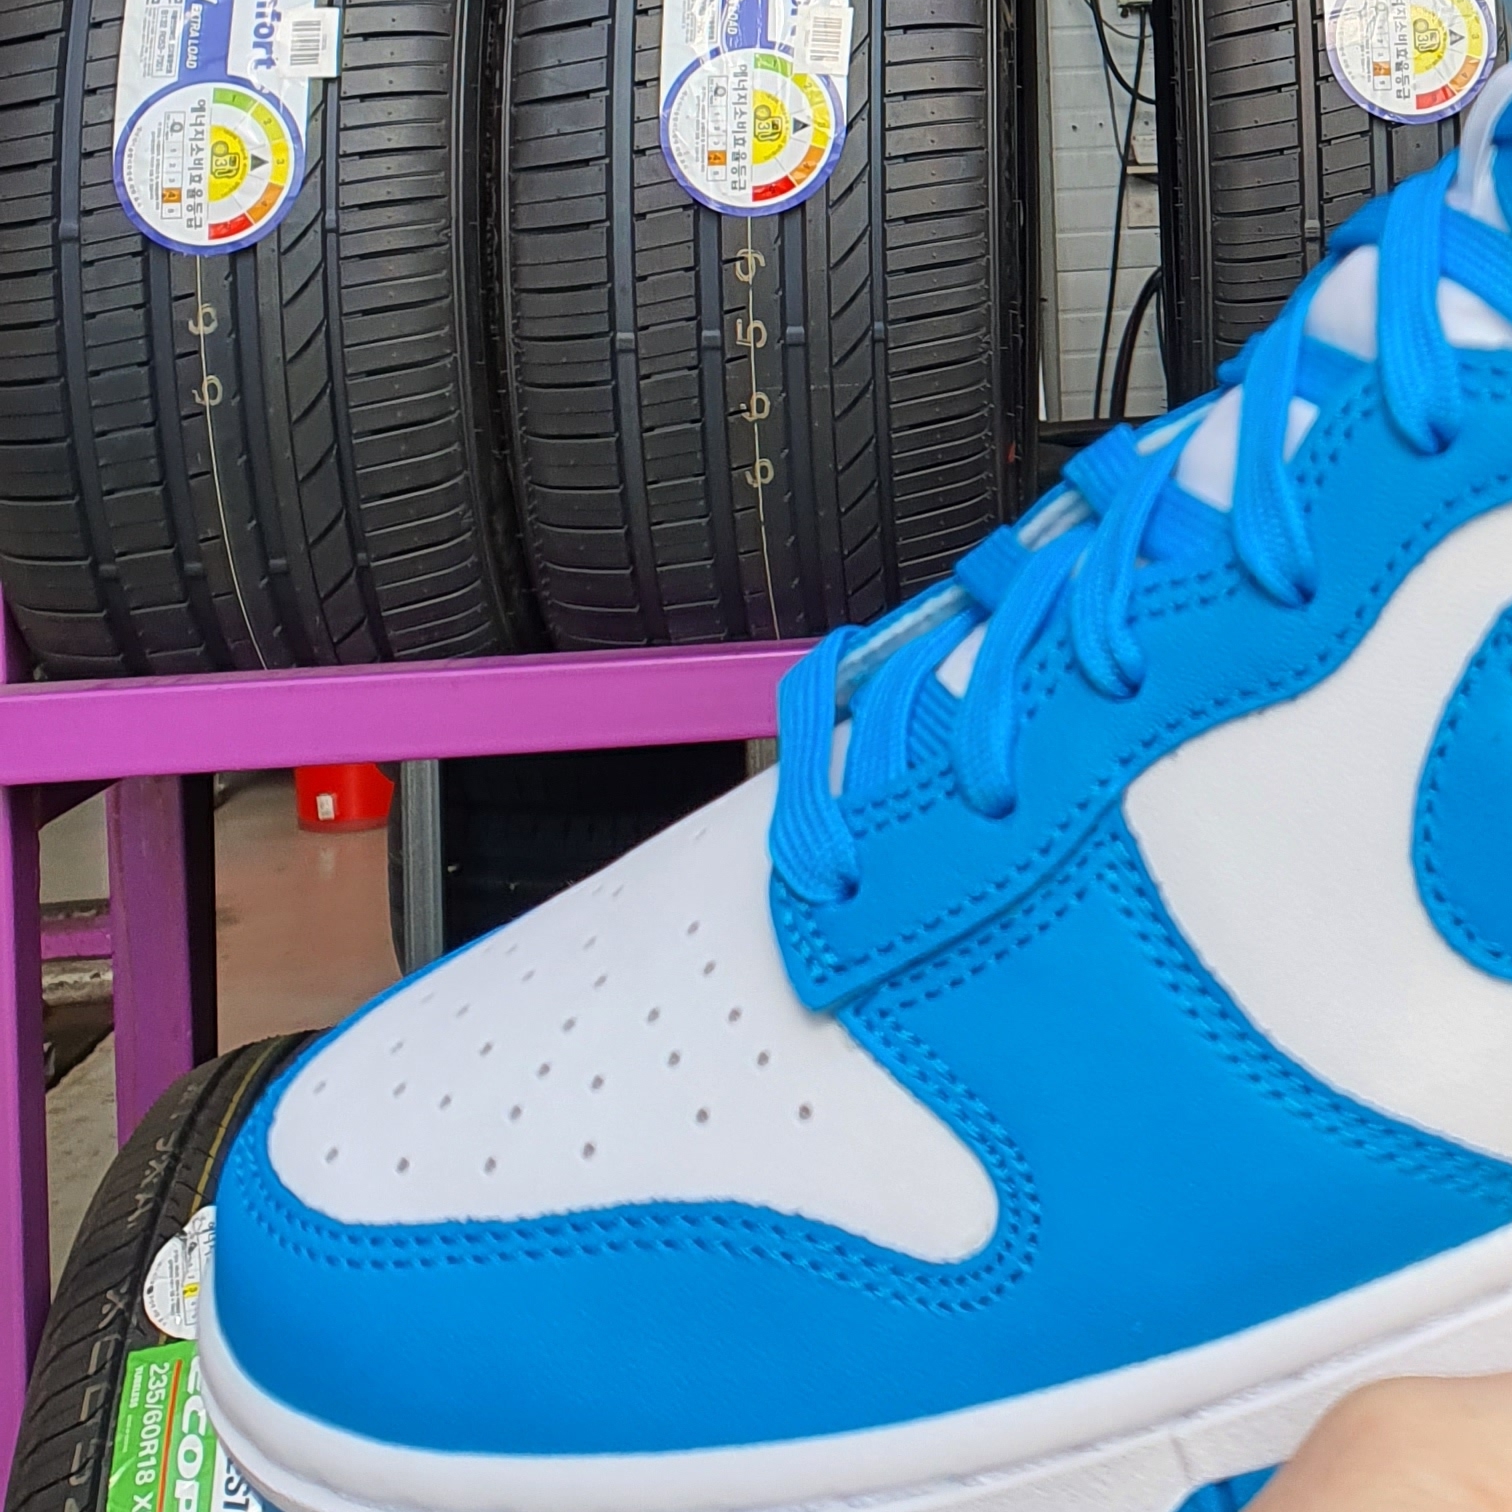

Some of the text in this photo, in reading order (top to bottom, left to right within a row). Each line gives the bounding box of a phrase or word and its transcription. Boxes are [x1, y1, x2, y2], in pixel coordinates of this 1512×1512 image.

[186, 40, 200, 70] LOAD
[186, 98, 206, 230] 에너지소비효율등급
[135, 1363, 170, 1487] 235/60R18
